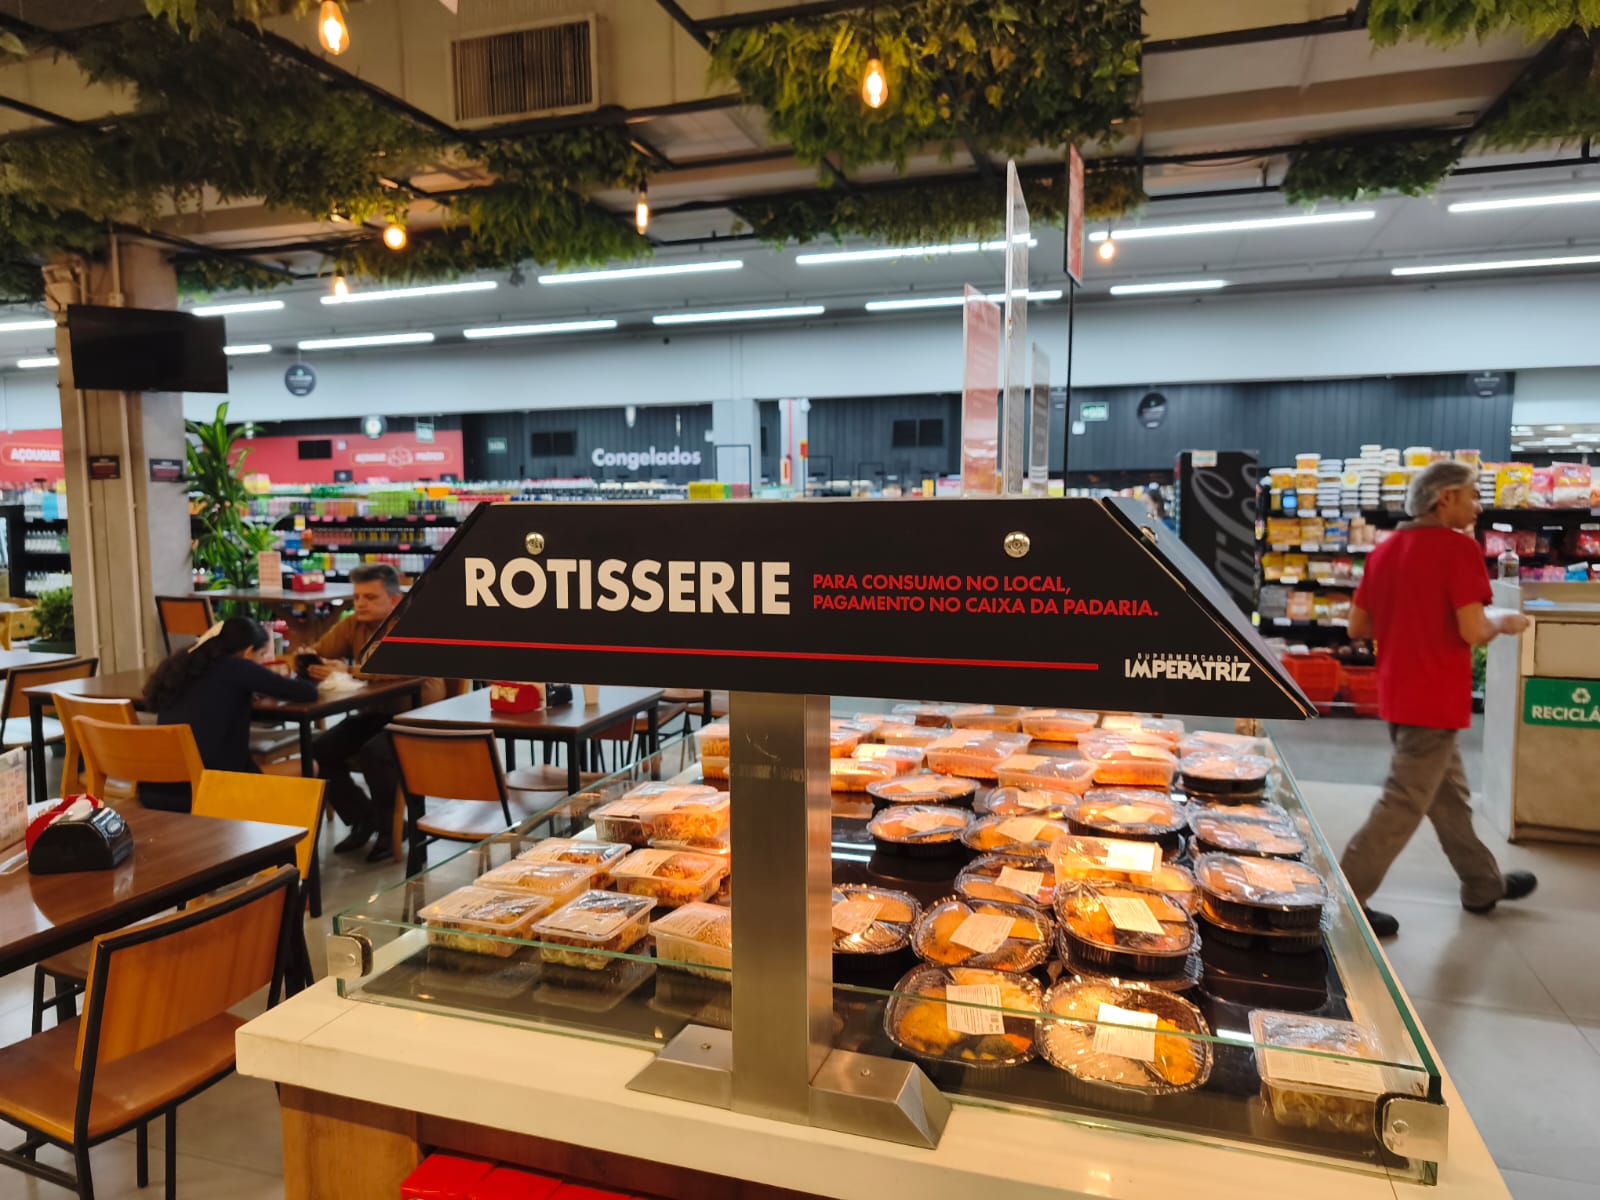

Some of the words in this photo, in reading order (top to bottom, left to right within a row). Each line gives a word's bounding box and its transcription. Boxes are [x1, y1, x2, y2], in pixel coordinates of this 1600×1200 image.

[592, 445, 702, 471] Congelados
[464, 557, 791, 615] ROTISSERIE
[813, 574, 858, 590] PARA
[862, 574, 962, 591] CONSUMO
[966, 575, 999, 592] NO
[1003, 575, 1071, 595] LOCAL,
[813, 594, 925, 612] PAGAMENTO
[929, 597, 961, 613] NO
[965, 597, 1026, 614] CAIXA
[1030, 598, 1059, 615] DA
[1063, 599, 1159, 616] PADARIA.
[1137, 652, 1239, 662] SUPERMERCADOS
[1124, 658, 1251, 682] IMPERATRIZ
